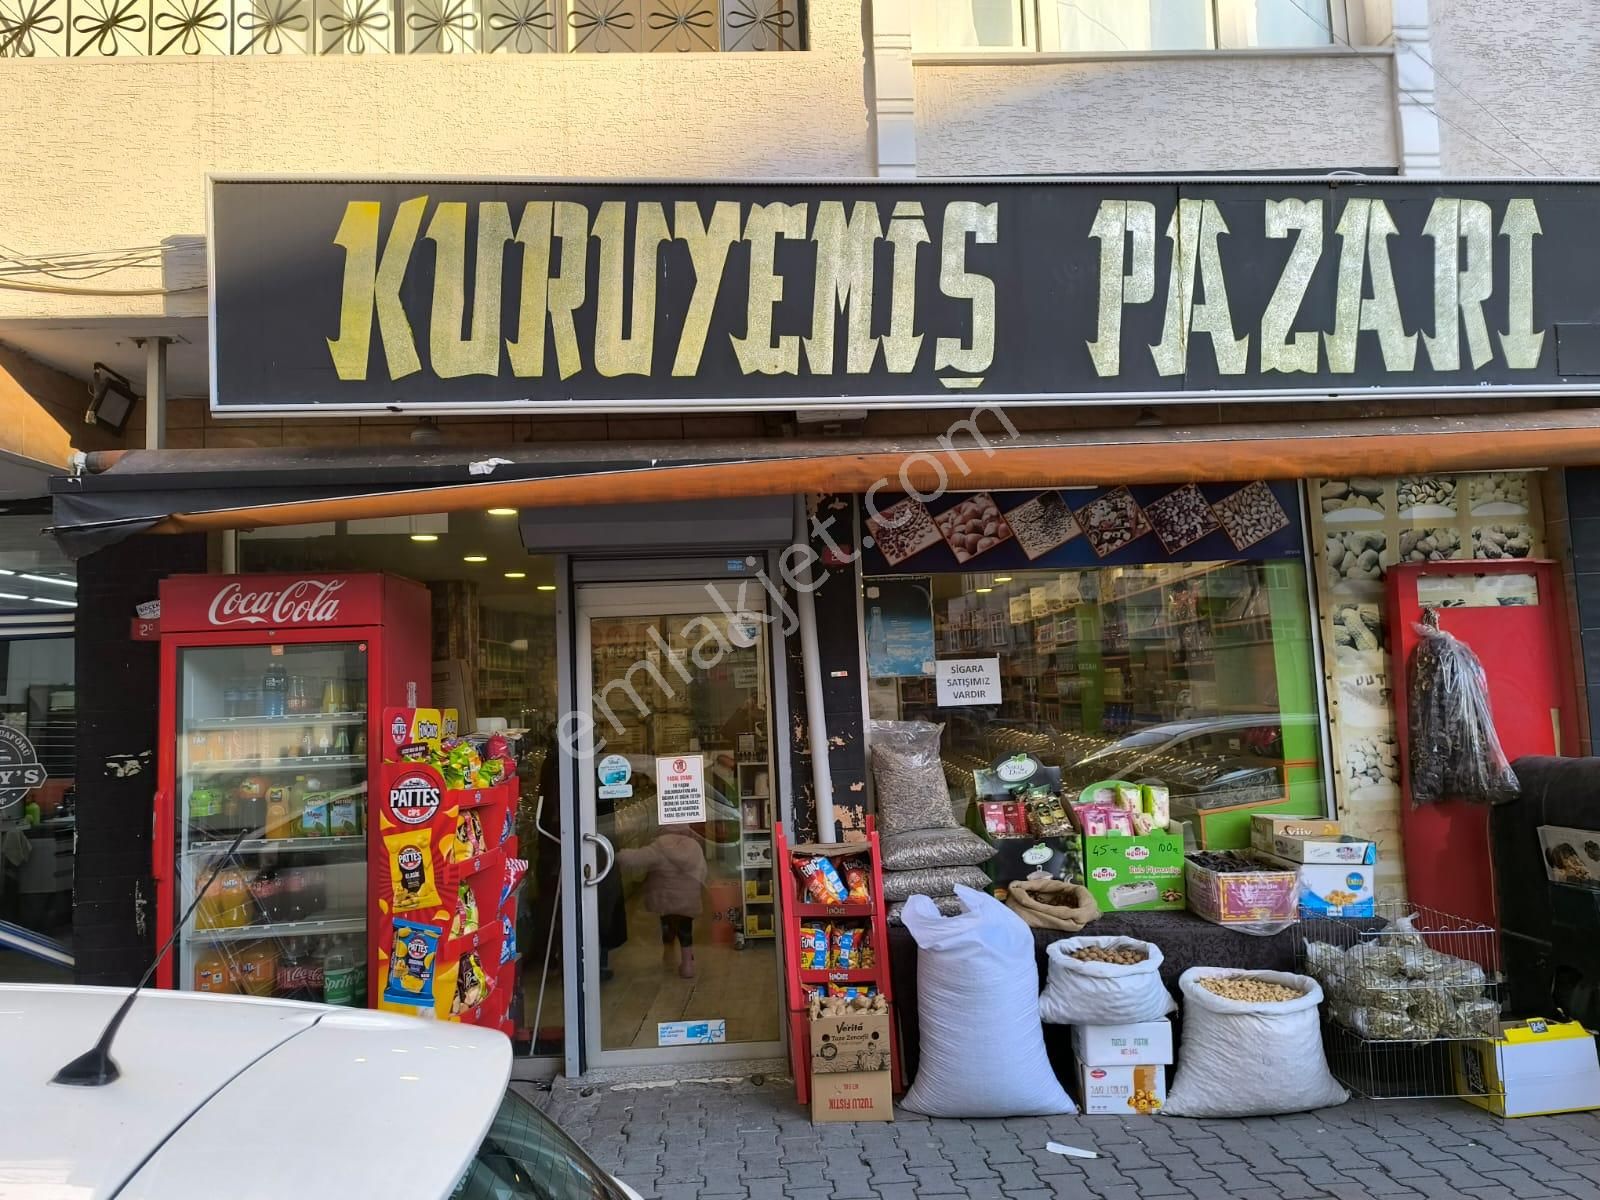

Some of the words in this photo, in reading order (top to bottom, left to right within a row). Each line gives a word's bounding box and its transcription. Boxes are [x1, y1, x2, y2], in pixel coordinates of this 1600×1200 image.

[326, 195, 998, 388] KURUYEMİŞ
[1086, 198, 1546, 377] PAZARI
[208, 579, 347, 625] Coca-Cola
[951, 664, 984, 674] SİGARA
[946, 677, 990, 688] SATIŞIMIZ
[952, 690, 986, 699] VARDIR
[390, 788, 440, 808] PATTES
[398, 851, 422, 864] PATTES
[407, 941, 429, 954] PATTES
